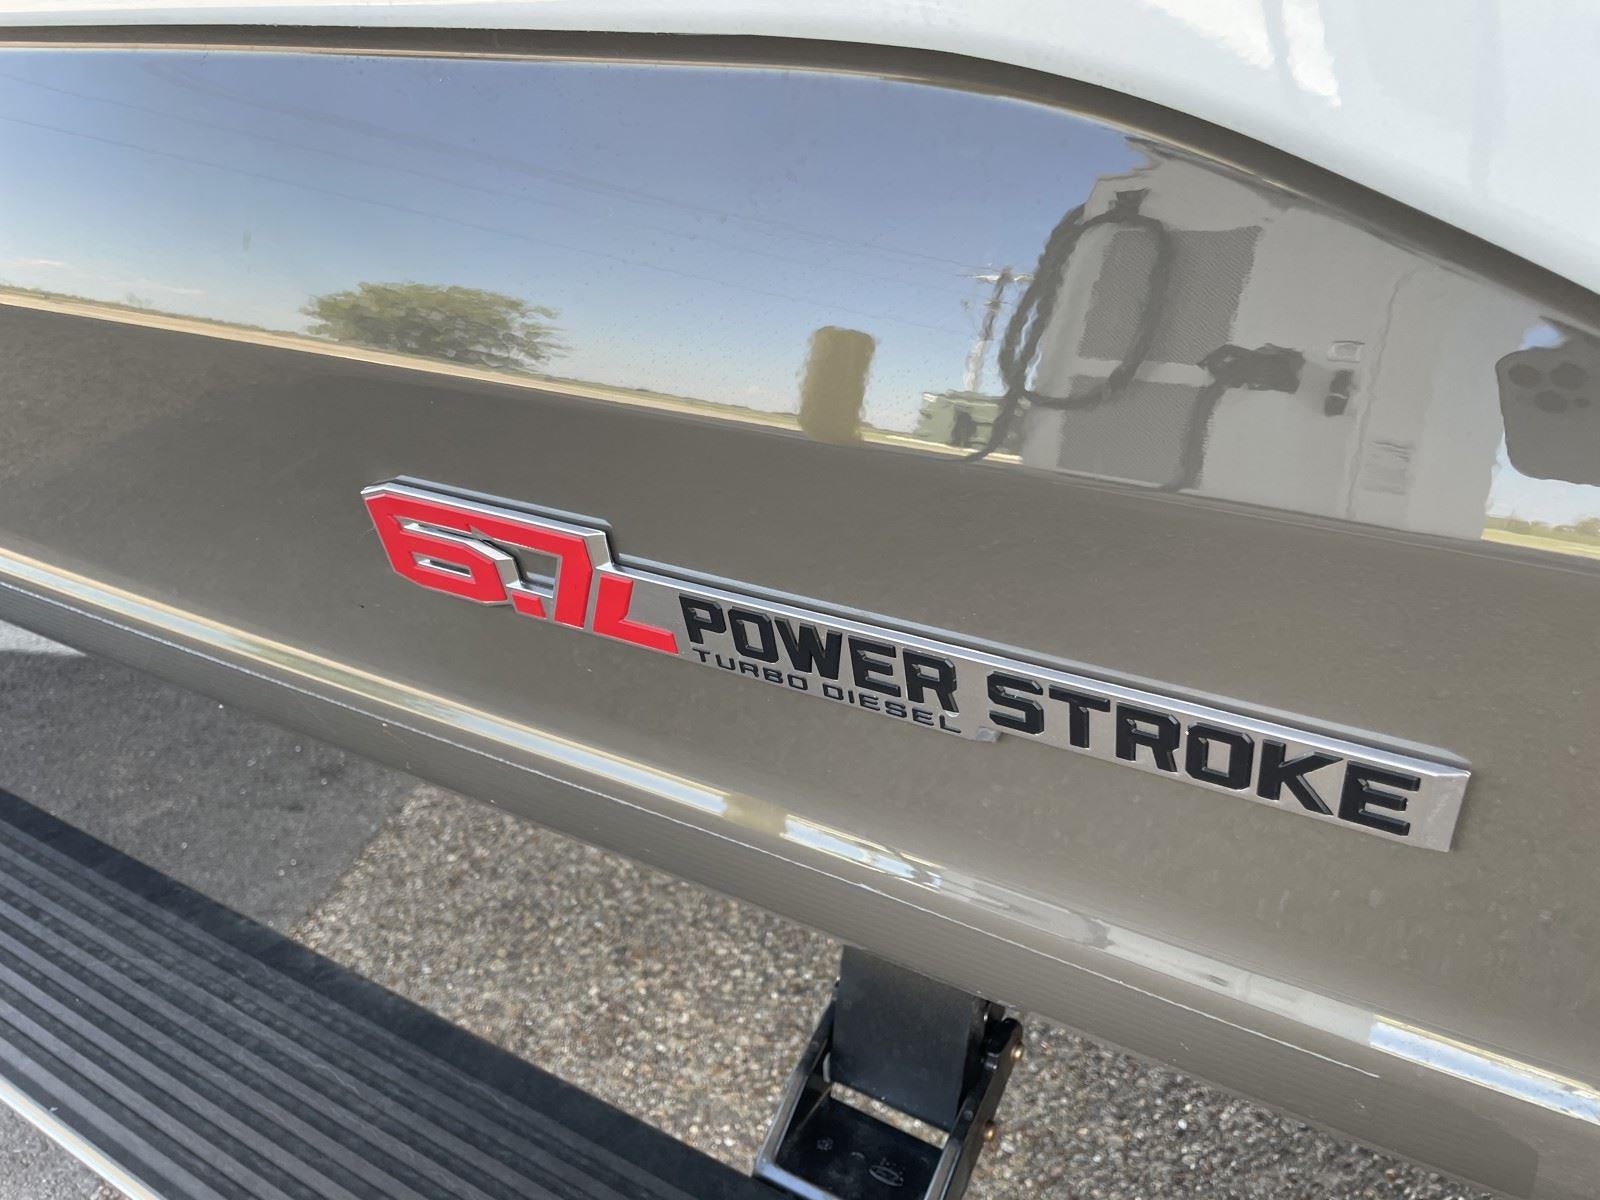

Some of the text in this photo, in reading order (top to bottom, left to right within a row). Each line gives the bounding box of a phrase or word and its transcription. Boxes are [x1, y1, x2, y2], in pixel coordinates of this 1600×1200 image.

[364, 492, 1421, 836] 6.7L POWER STROKE
[692, 648, 962, 734] TURBO DIESEL
